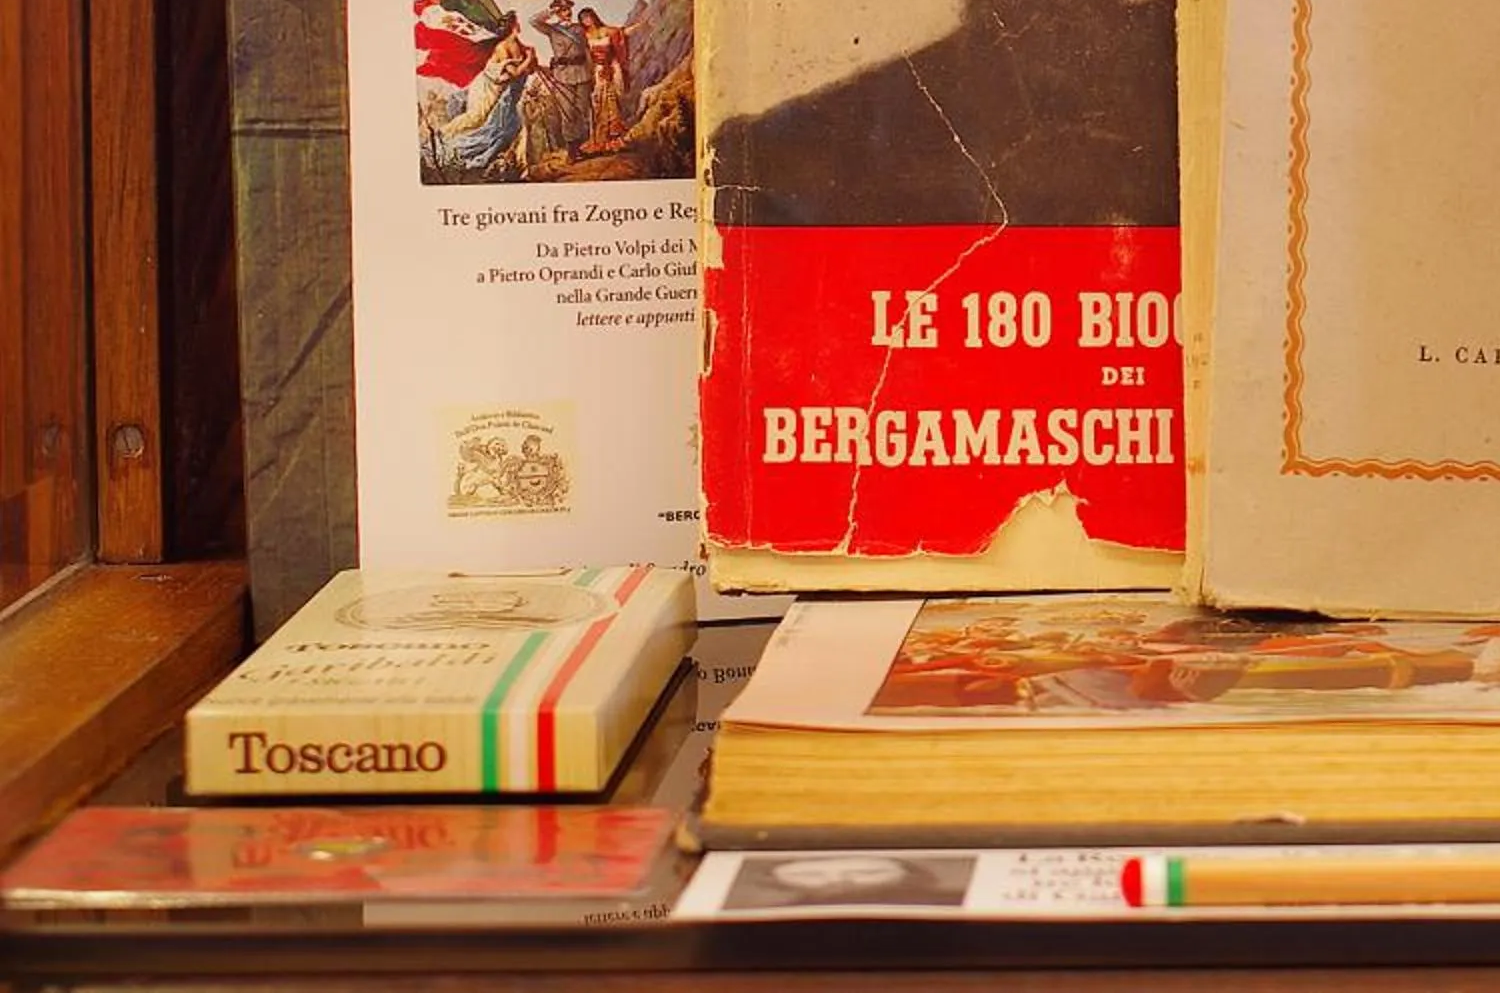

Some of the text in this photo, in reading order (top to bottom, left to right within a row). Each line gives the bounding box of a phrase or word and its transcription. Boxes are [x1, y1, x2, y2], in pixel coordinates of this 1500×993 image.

[439, 208, 470, 226] Tre
[476, 206, 547, 231] giovani
[552, 204, 579, 224] fra
[585, 203, 648, 227] Zogno
[653, 207, 663, 220] e
[536, 243, 559, 258] Da
[563, 241, 611, 258] Pietro
[615, 239, 656, 259] Volpi
[661, 238, 683, 254] dei
[476, 272, 486, 283] a
[489, 267, 535, 283] Pietro
[539, 264, 603, 285] Oprandi
[607, 268, 616, 279] e
[619, 262, 660, 278] Carlo
[556, 288, 592, 304] nella
[595, 286, 652, 303] Grande
[576, 309, 695, 328] lettere e appunti
[871, 290, 1184, 348] LE 180 BIO
[1418, 344, 1440, 362] L.
[1100, 366, 1145, 386] DEI
[763, 407, 1174, 466] BERGAMASCHI
[228, 731, 448, 775] Toscano
